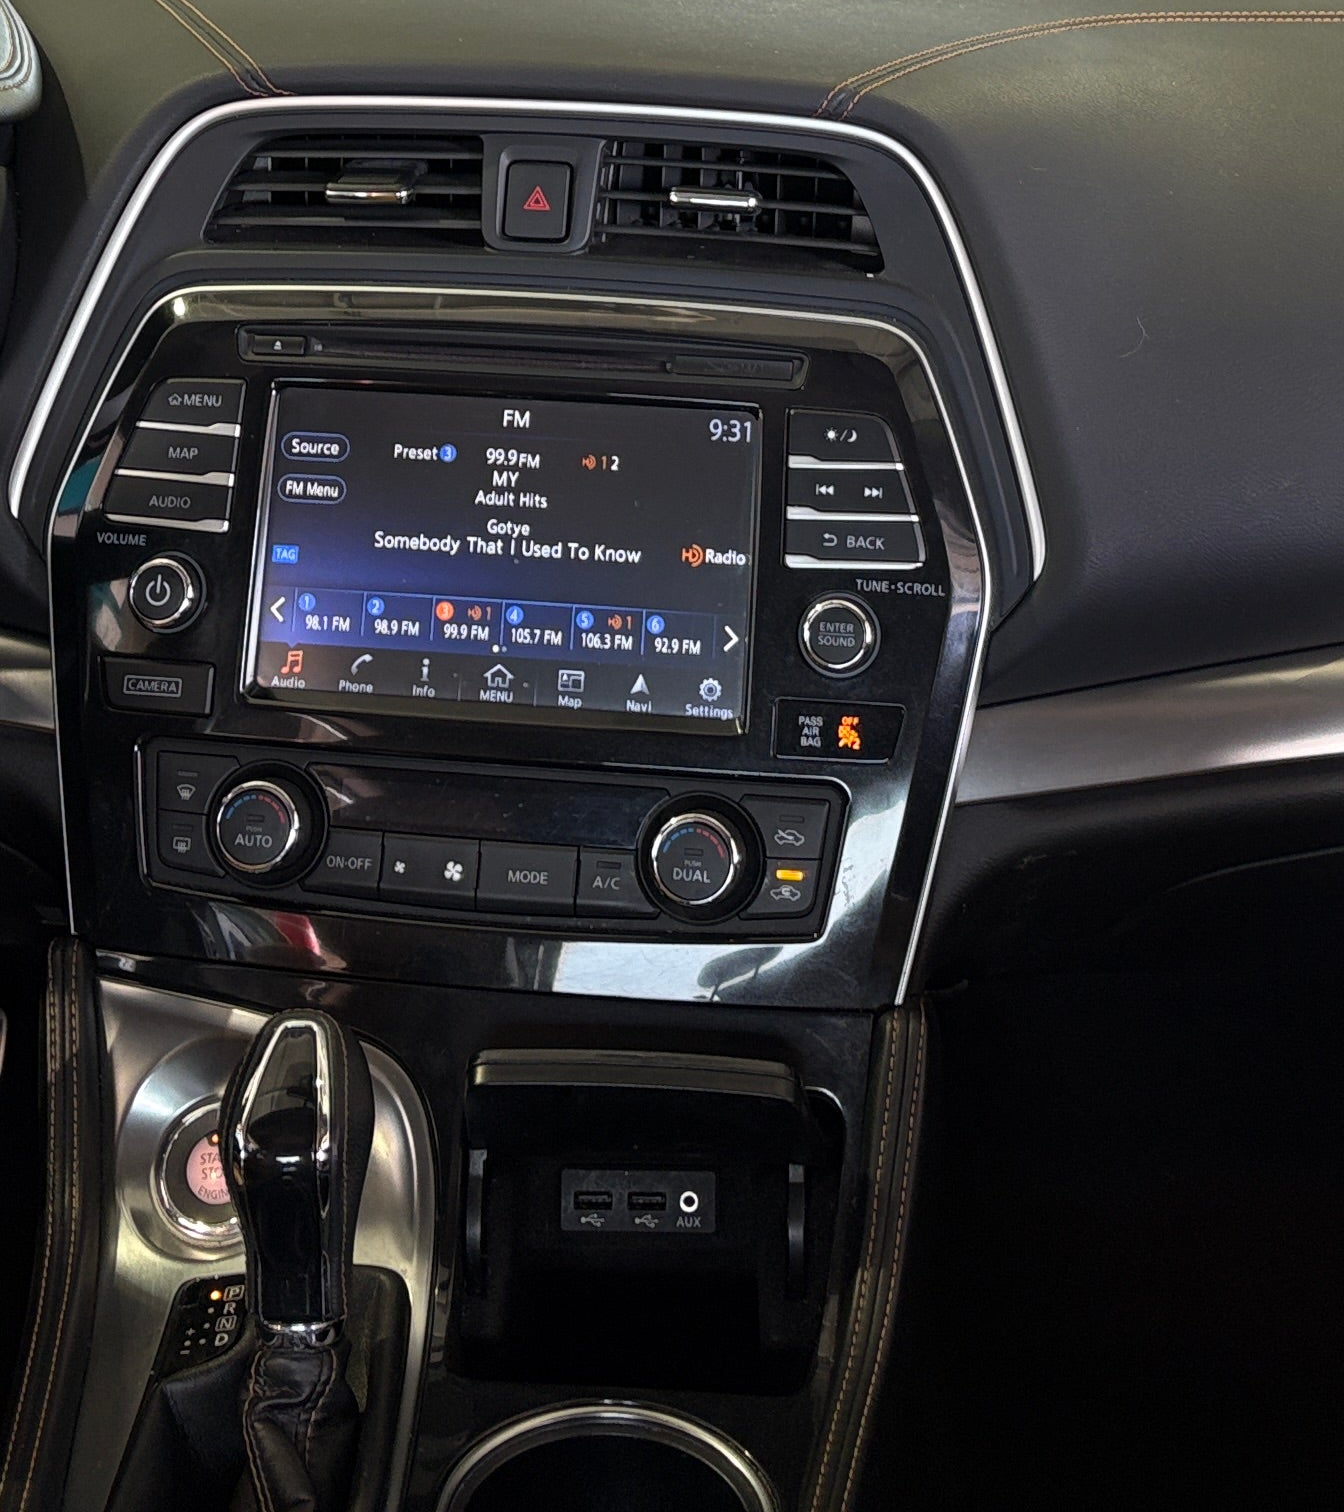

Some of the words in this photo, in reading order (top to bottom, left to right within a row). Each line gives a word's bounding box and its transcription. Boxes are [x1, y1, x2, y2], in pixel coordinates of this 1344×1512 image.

[183, 394, 223, 407] MENU
[503, 410, 531, 428] FM
[709, 418, 753, 443] 9:31
[168, 446, 199, 460] MAP
[291, 438, 340, 456] Source
[394, 444, 438, 461] Preset
[610, 456, 619, 471] 2
[492, 471, 519, 488] MY
[286, 480, 304, 495] FM
[306, 481, 339, 498] Menu
[149, 495, 192, 509] AUDIO
[475, 491, 516, 508] Adult
[519, 493, 548, 509] Hits
[486, 519, 531, 538] Gotye
[96, 532, 147, 547] VOLUME
[846, 536, 885, 550] BACK
[275, 547, 297, 561] TAG
[374, 531, 460, 555] Somebody
[467, 537, 504, 556] That
[522, 540, 563, 559] Used
[568, 543, 589, 561] To
[594, 546, 642, 564] Know
[705, 549, 746, 566] Radio
[305, 614, 329, 631] 98.1
[332, 616, 351, 632] FM
[374, 619, 398, 635] 98.9
[401, 620, 420, 636] FM
[819, 621, 855, 634] ENTER
[443, 623, 467, 639] 99.9
[470, 625, 490, 641] FM
[511, 628, 539, 645] 105.7
[544, 630, 563, 646] FM
[581, 632, 611, 650] 106.3
[614, 634, 633, 651] FM
[654, 638, 679, 654] 92.9
[682, 639, 701, 656] FM
[818, 635, 855, 648] SOUND
[128, 679, 178, 693] CAMERA
[271, 676, 306, 689] Audio
[338, 679, 374, 694] Phone
[412, 684, 436, 698] Info
[479, 689, 514, 704] MENU
[557, 695, 583, 709] Map
[626, 699, 652, 713] Navi
[685, 703, 734, 720] Settings
[798, 715, 823, 727] PASS
[801, 726, 820, 736] AIR
[800, 736, 821, 747] BAG
[234, 833, 273, 848] AUTO
[508, 870, 549, 885] MODE
[672, 867, 711, 884] DUAL
[592, 876, 621, 891] A/C
[200, 1152, 221, 1166] STA
[201, 1166, 223, 1180] STO
[197, 1184, 229, 1200] ENGIN
[676, 1216, 701, 1228] AUX
[223, 1302, 236, 1315] R
[214, 1332, 228, 1347] D
